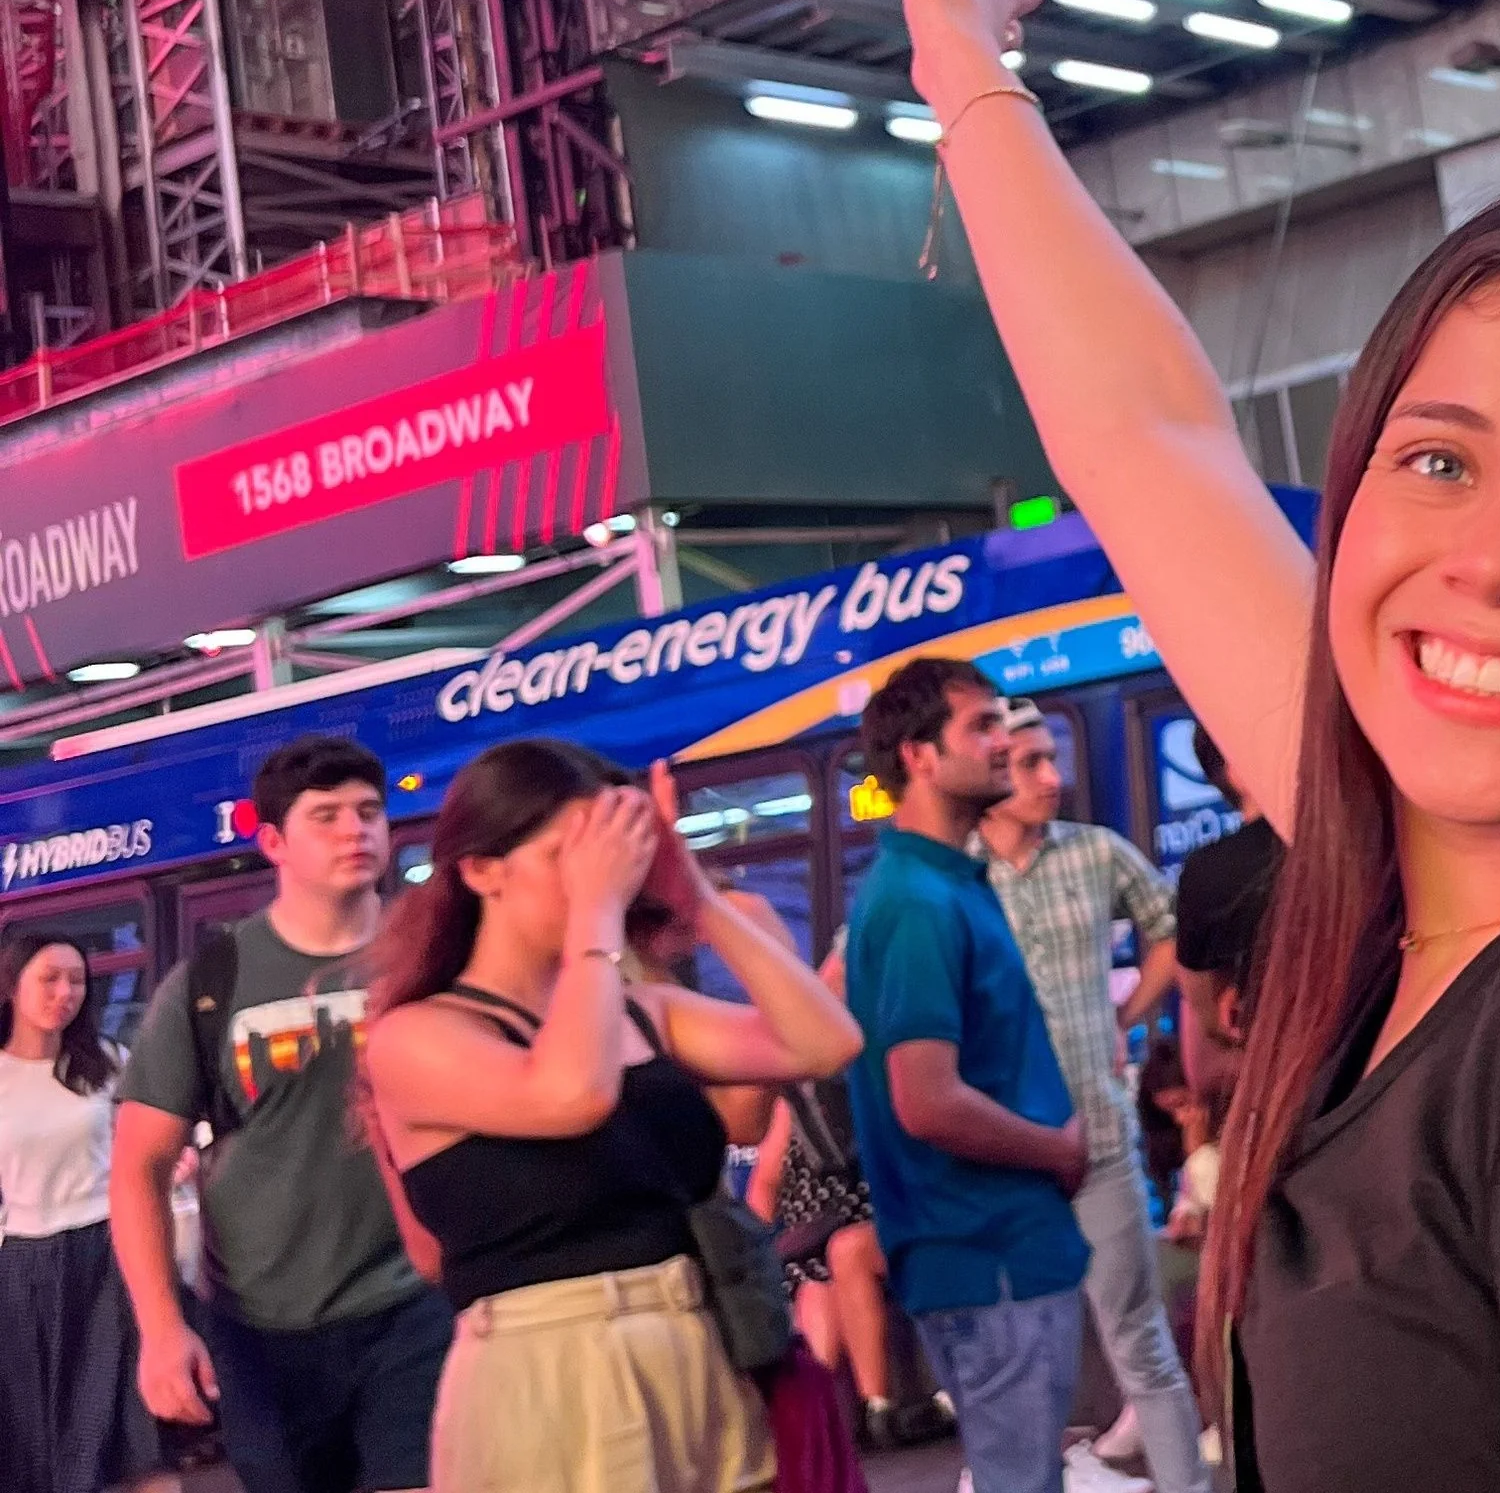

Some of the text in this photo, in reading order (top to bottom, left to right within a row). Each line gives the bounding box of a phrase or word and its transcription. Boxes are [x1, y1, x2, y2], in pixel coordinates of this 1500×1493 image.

[231, 376, 534, 516] 1568 BROADWAY
[434, 554, 972, 723] clean-energy bus
